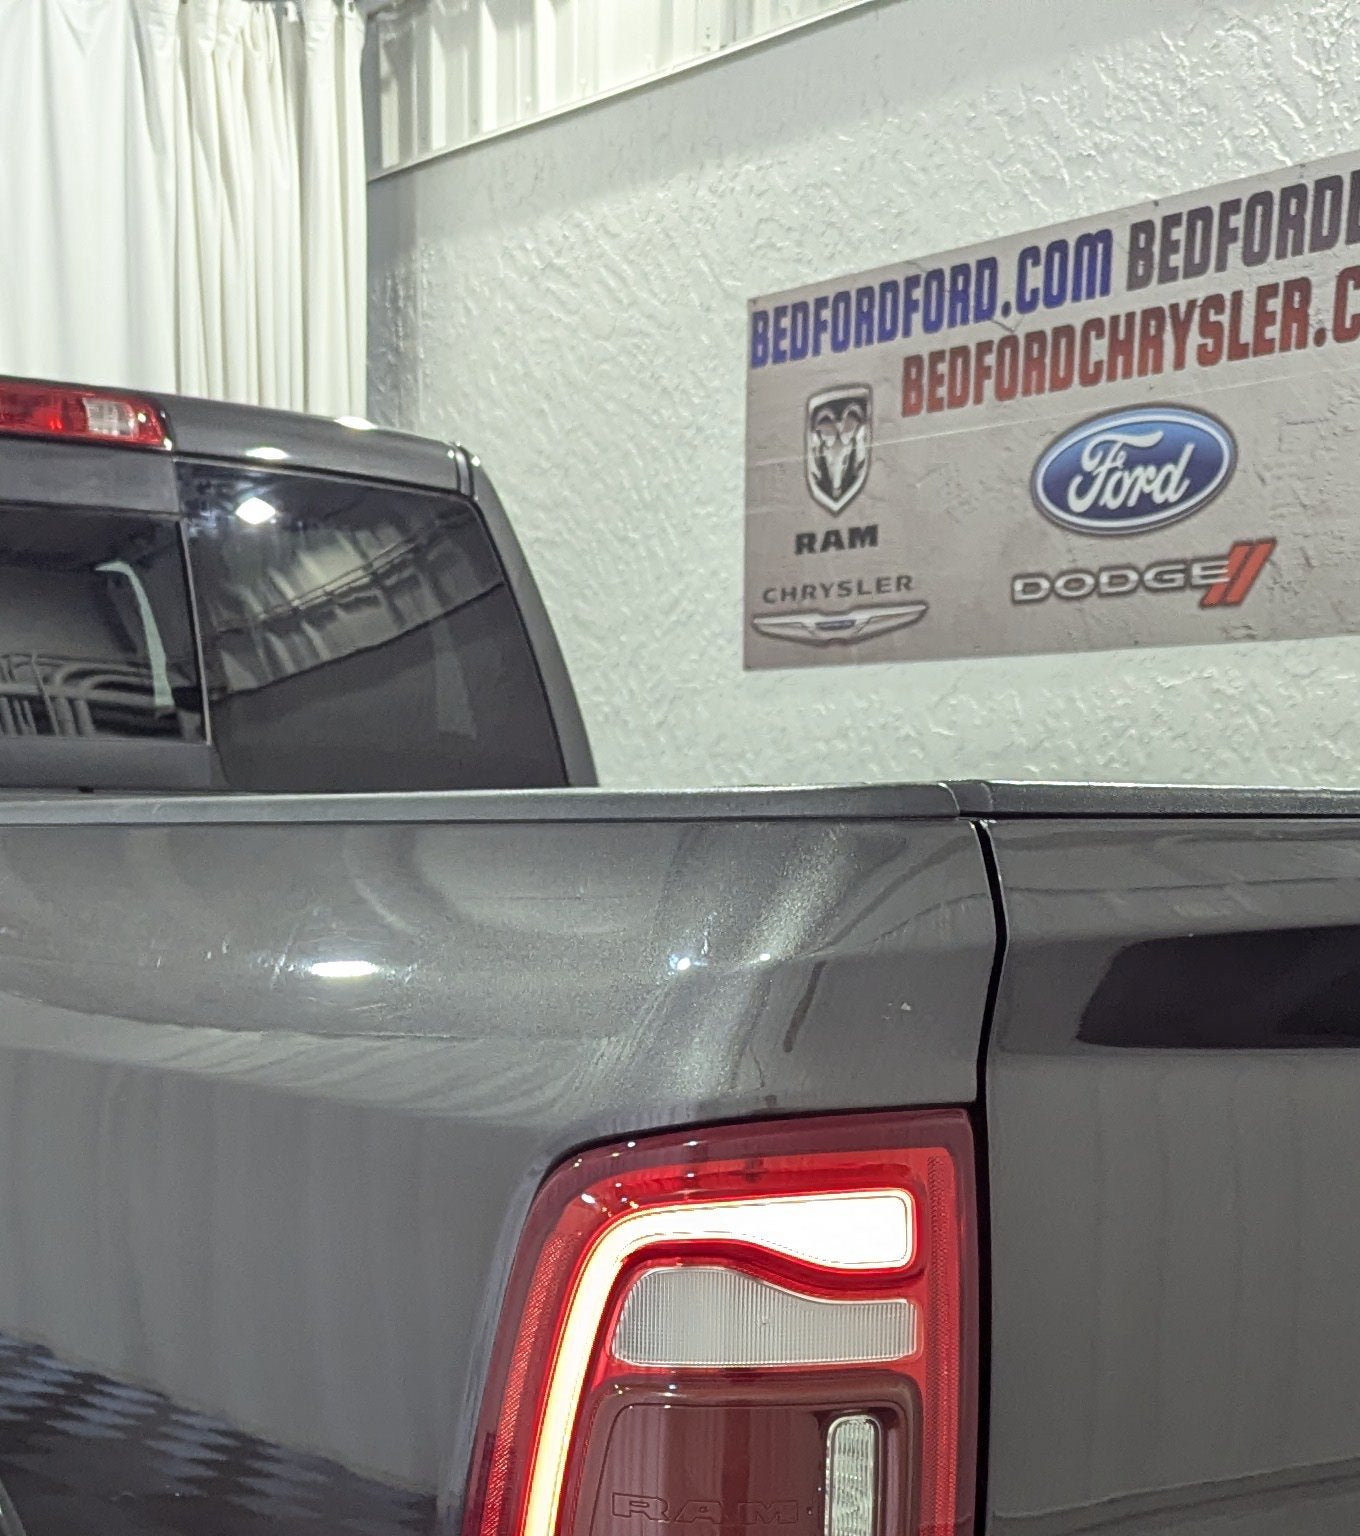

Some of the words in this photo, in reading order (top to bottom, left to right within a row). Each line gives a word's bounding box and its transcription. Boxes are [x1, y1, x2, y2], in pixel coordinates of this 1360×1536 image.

[750, 228, 1113, 370] BEDFORDFORD.COM
[1067, 431, 1194, 516] Ford
[794, 524, 880, 556] RAM
[762, 574, 913, 604] CHRYSLER
[1011, 554, 1230, 605] DODGE
[611, 1491, 800, 1525] RAM
